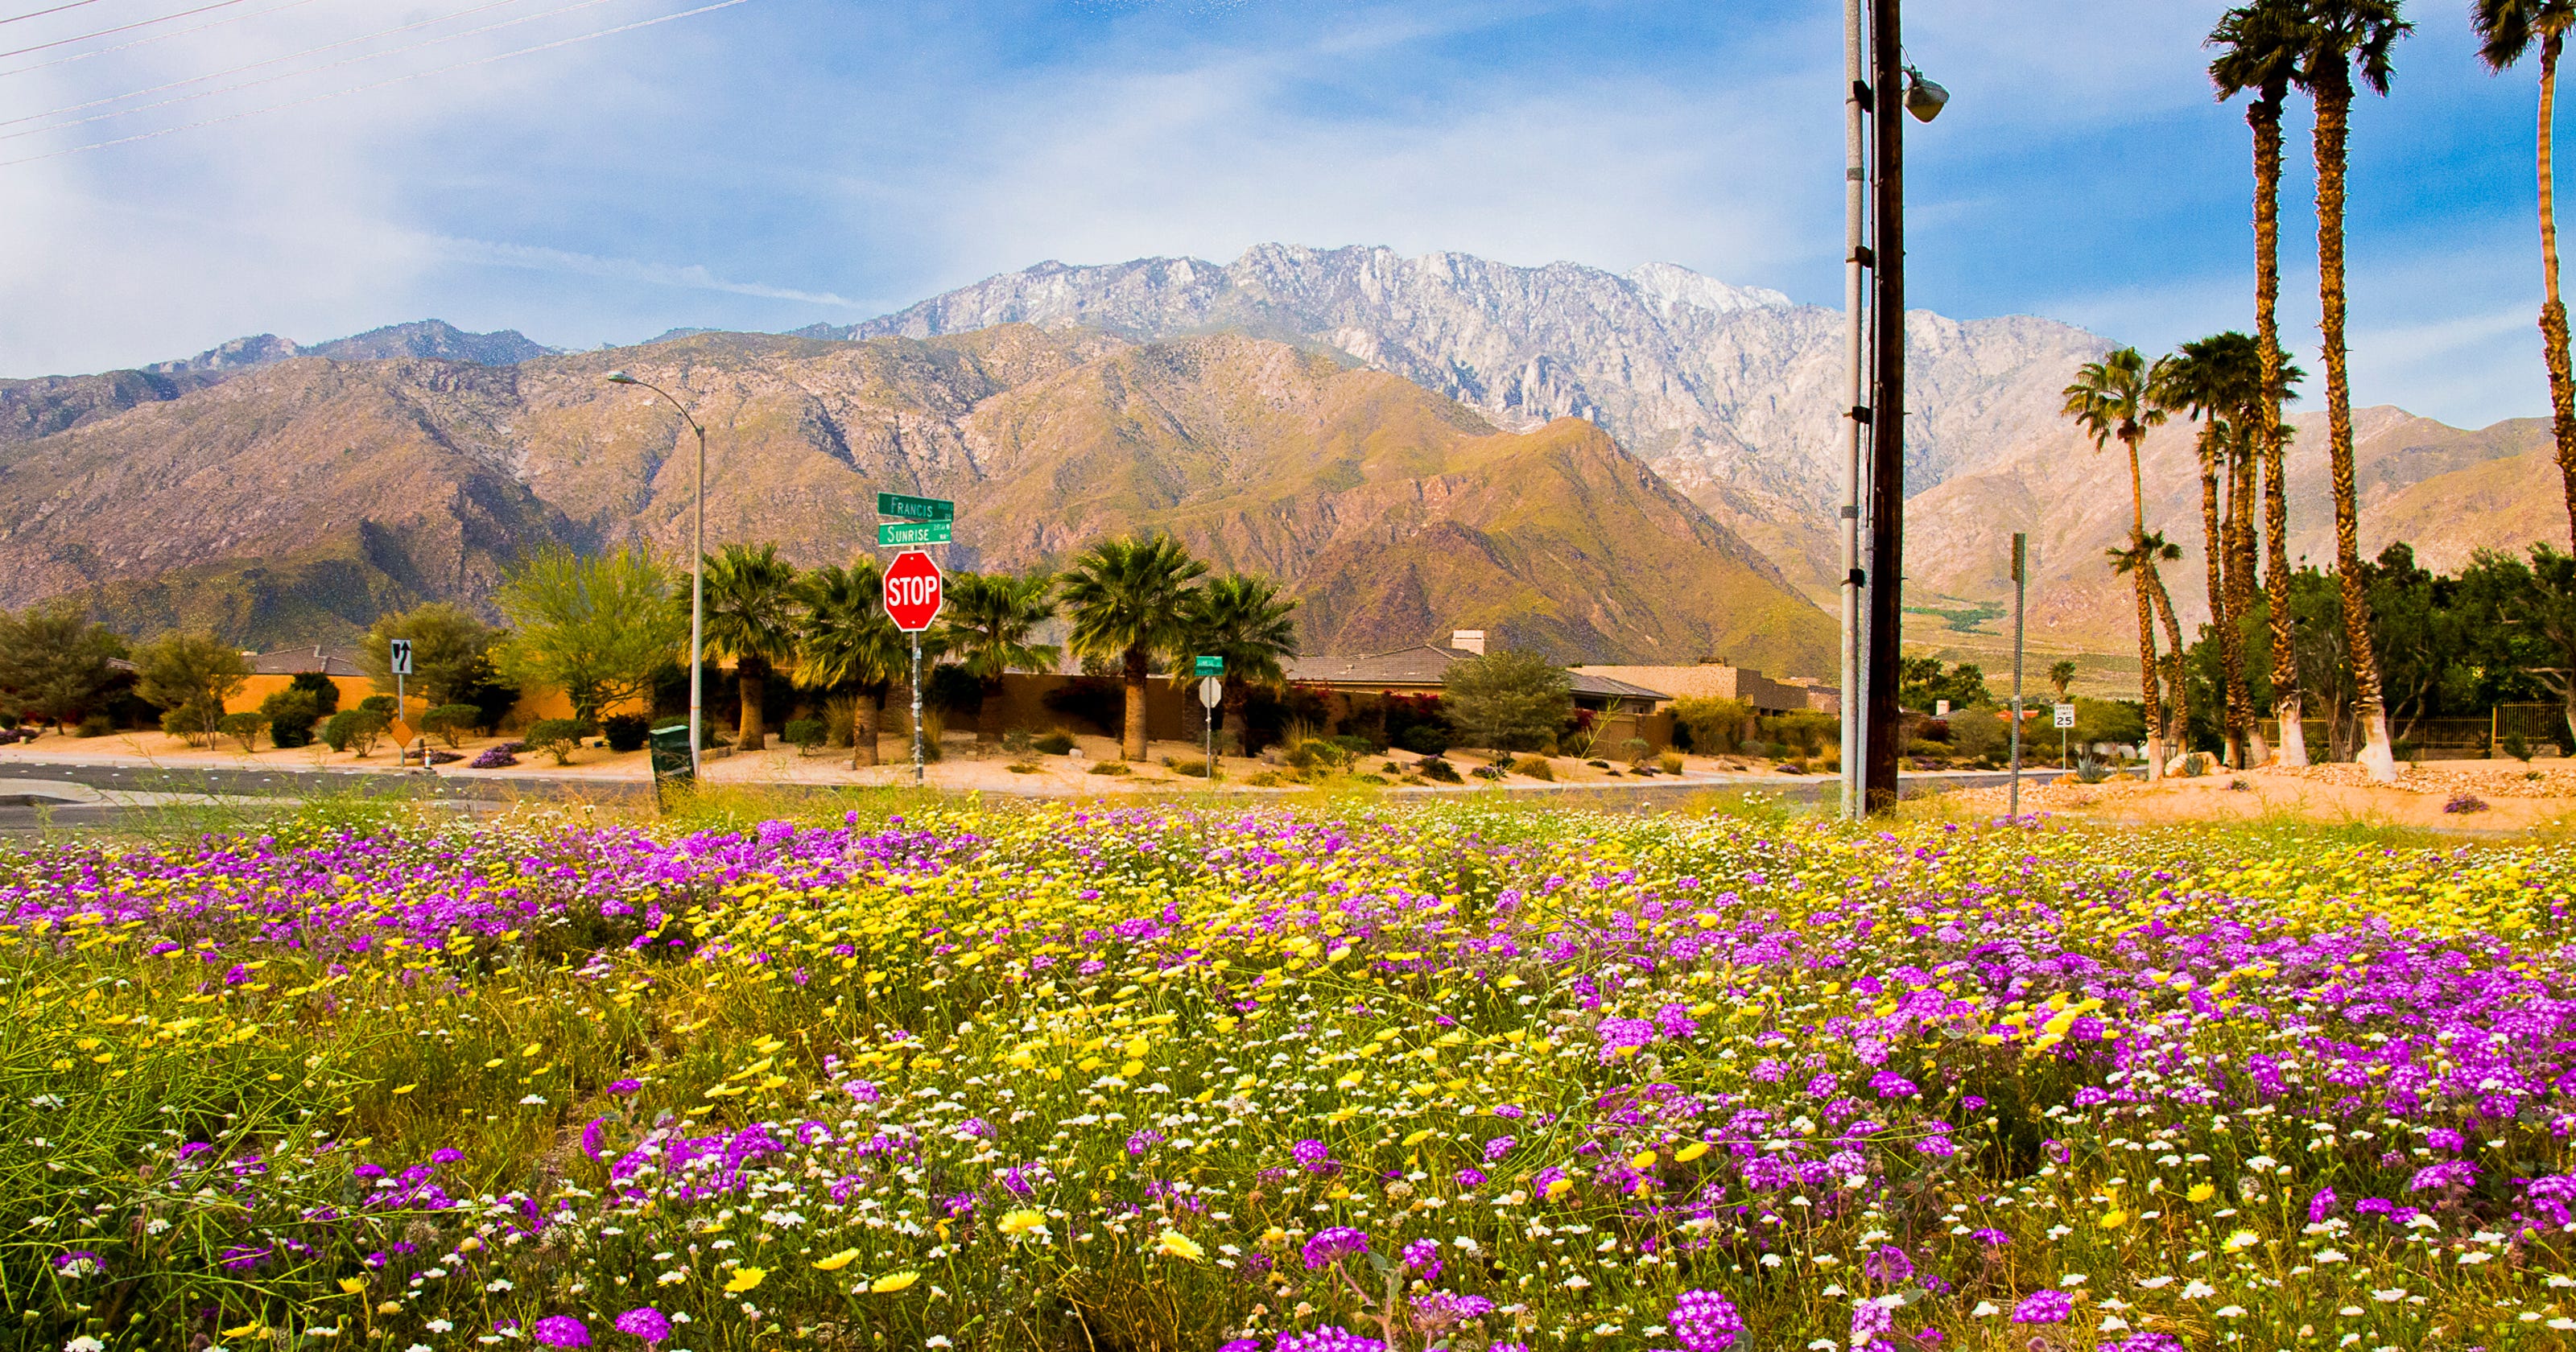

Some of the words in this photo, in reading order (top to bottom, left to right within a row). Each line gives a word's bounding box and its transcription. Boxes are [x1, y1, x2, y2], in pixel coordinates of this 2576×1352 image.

[890, 497, 933, 517] FRANCIS
[887, 526, 930, 542] SUNRISE
[888, 575, 938, 607] STOP
[2057, 716, 2072, 725] 25
